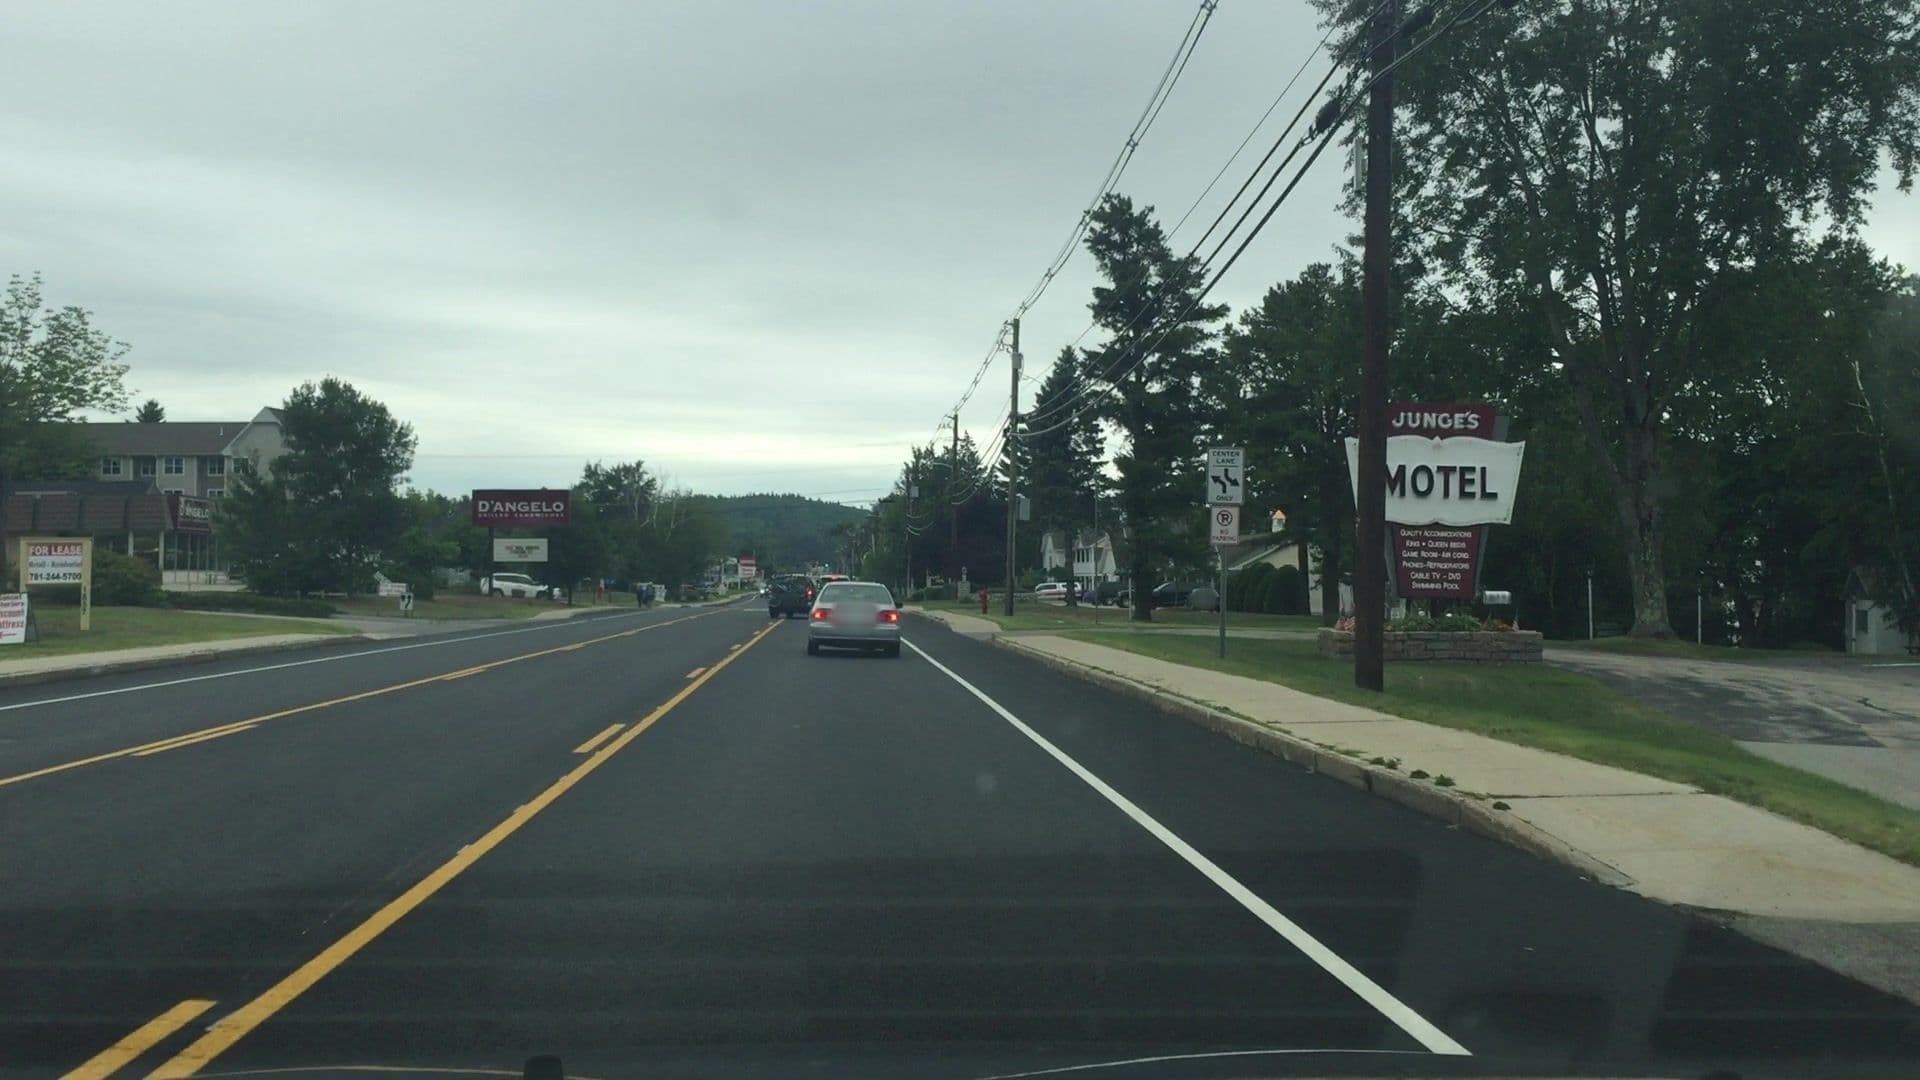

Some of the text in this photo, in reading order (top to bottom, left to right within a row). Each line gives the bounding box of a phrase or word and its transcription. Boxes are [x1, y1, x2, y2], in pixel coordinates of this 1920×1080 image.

[1391, 411, 1480, 430] JUNGE'S
[1385, 463, 1499, 500] MOTEL
[478, 500, 565, 512] D'ANGELO
[30, 545, 82, 555] FOR LEASE
[1410, 571, 1430, 579] CABLE
[1431, 572, 1441, 580] TV
[1448, 572, 1462, 580] DVD
[1442, 582, 1460, 590] POOL
